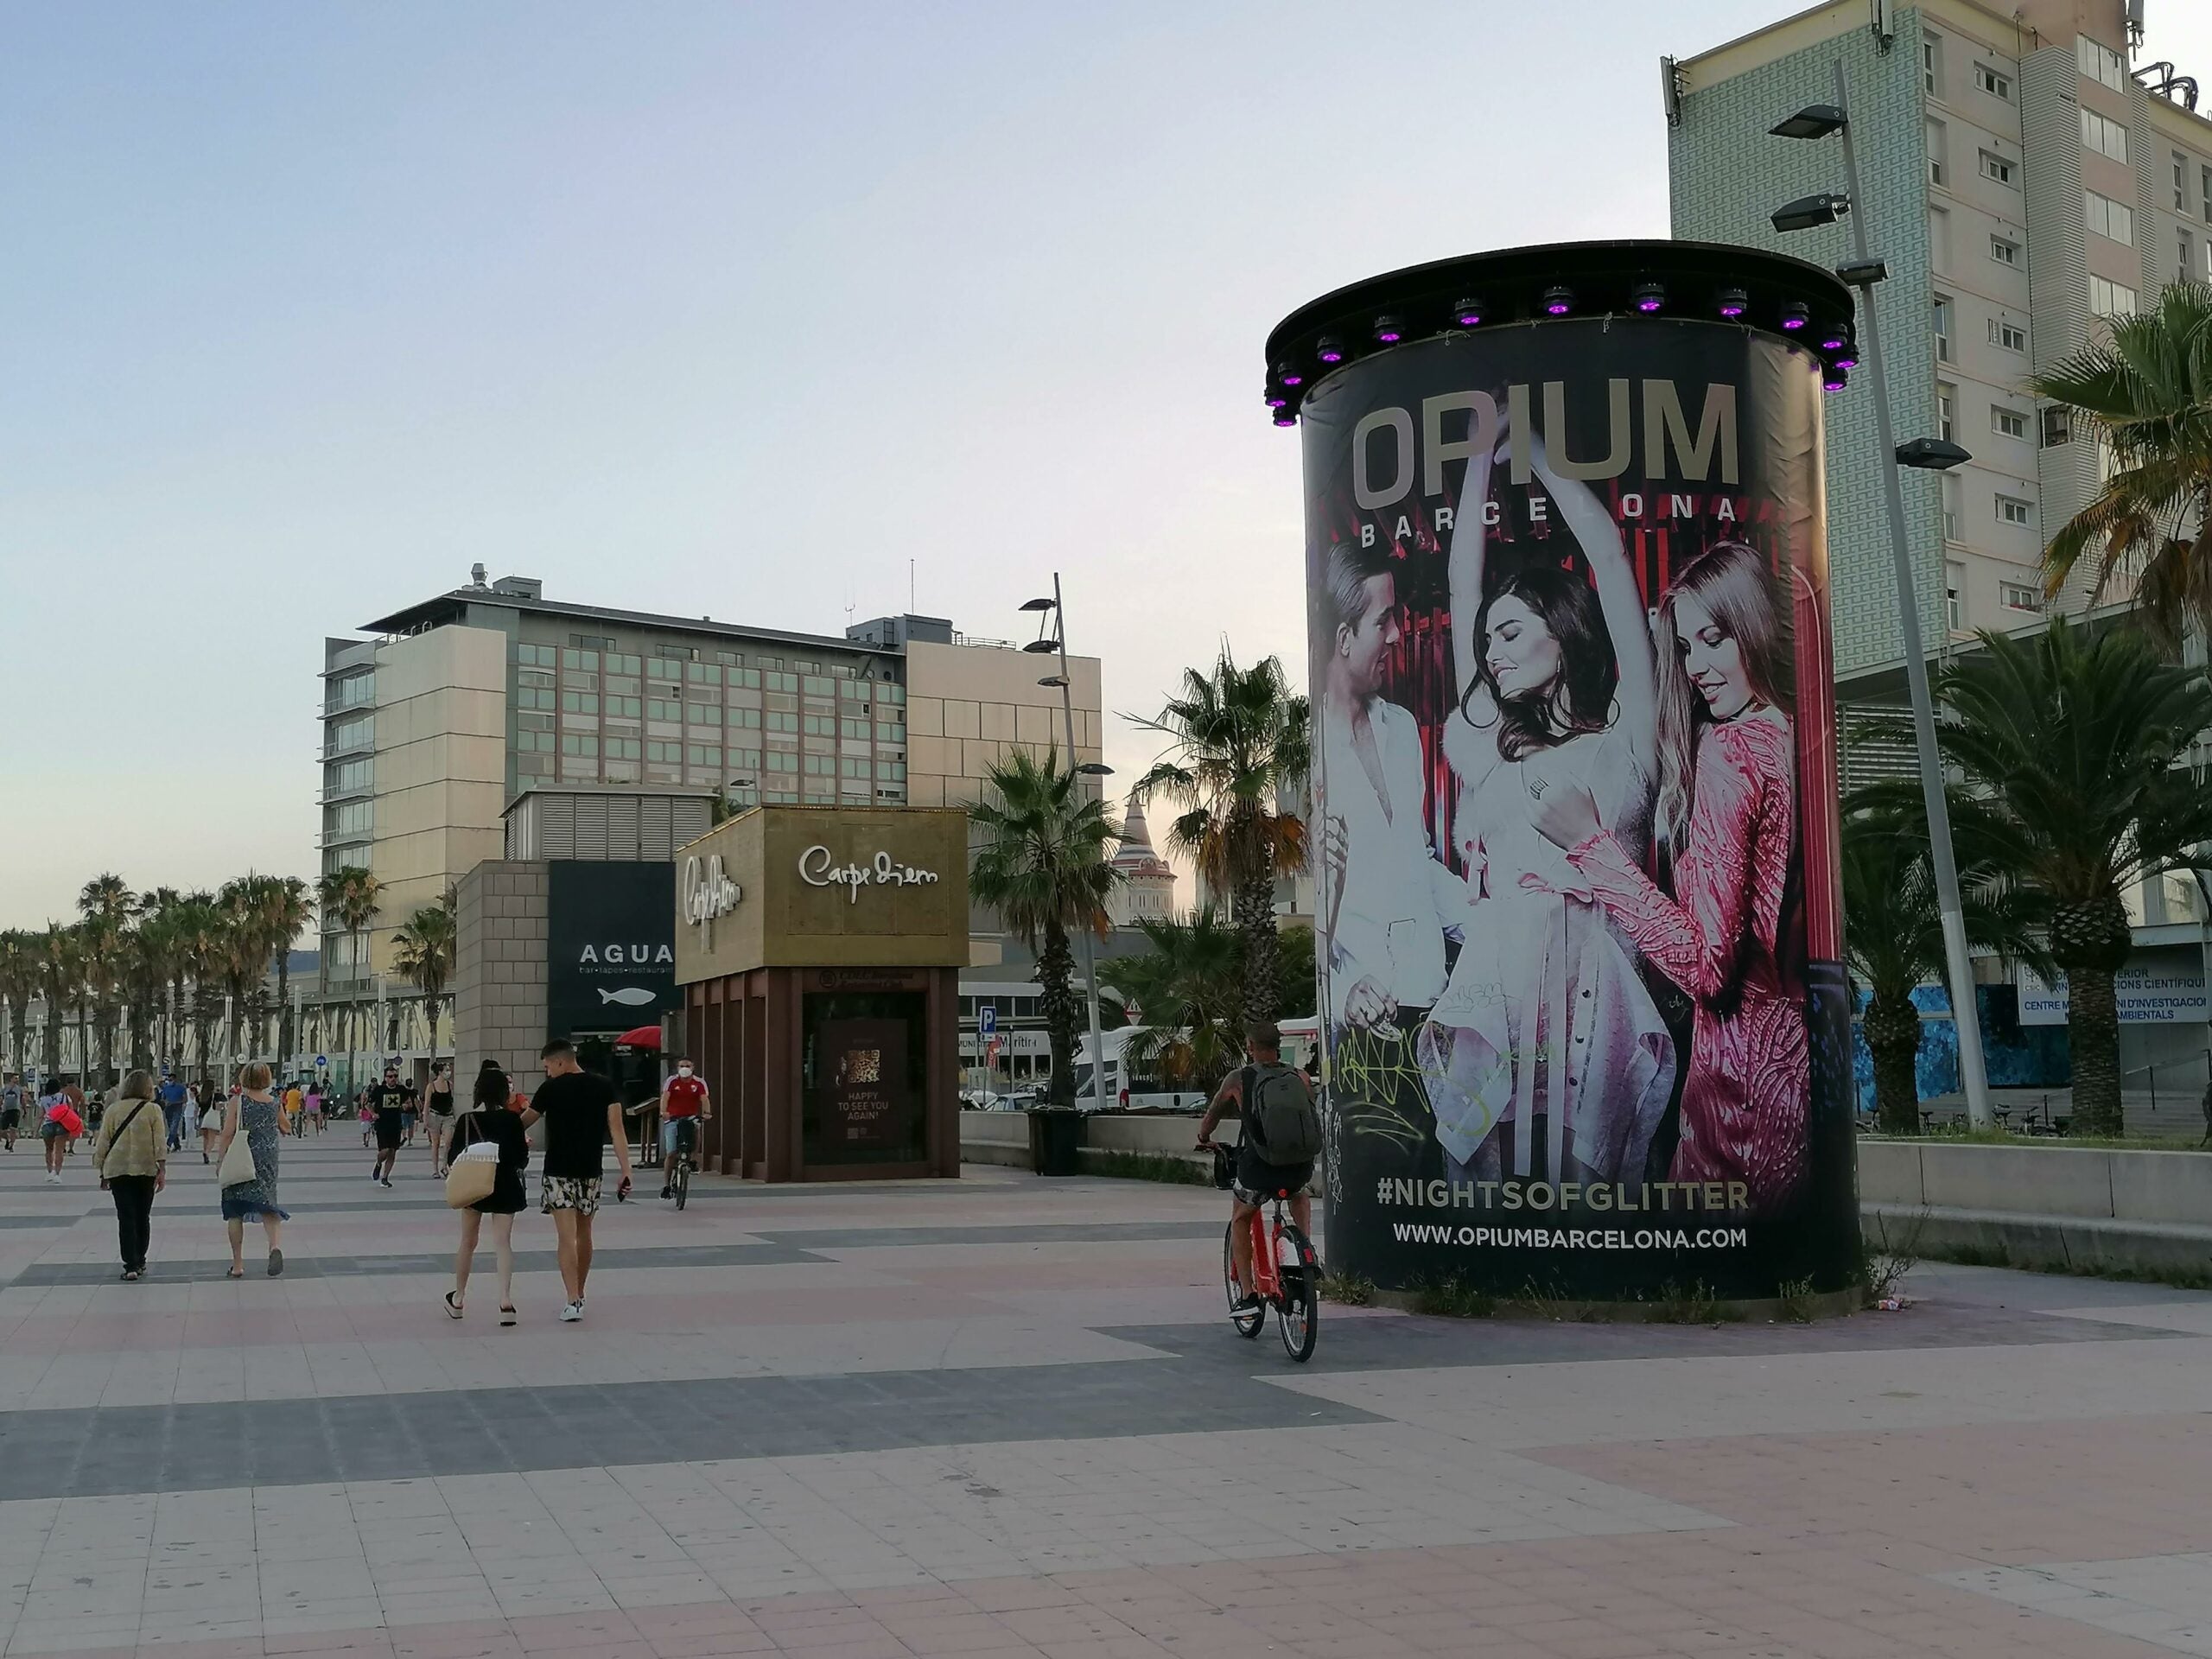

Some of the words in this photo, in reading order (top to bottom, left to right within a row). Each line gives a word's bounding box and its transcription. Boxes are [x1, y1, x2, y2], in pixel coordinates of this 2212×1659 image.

[1352, 378, 1739, 511] OPIUM
[798, 845, 871, 905] Carpe
[579, 944, 674, 963] AGUA
[2024, 1001, 2061, 1010] CENTRE
[983, 1009, 994, 1031] P
[848, 1091, 879, 1101] HAPPY
[838, 1102, 849, 1111] TO
[851, 1102, 868, 1111] SEE
[870, 1102, 889, 1110] YOU
[847, 1111, 879, 1121] AGAIN!
[1376, 1176, 1749, 1211] #NIGHTSOFGLITTER
[1393, 1222, 1748, 1249] WWW.OPIUMBARCELONA.COM
